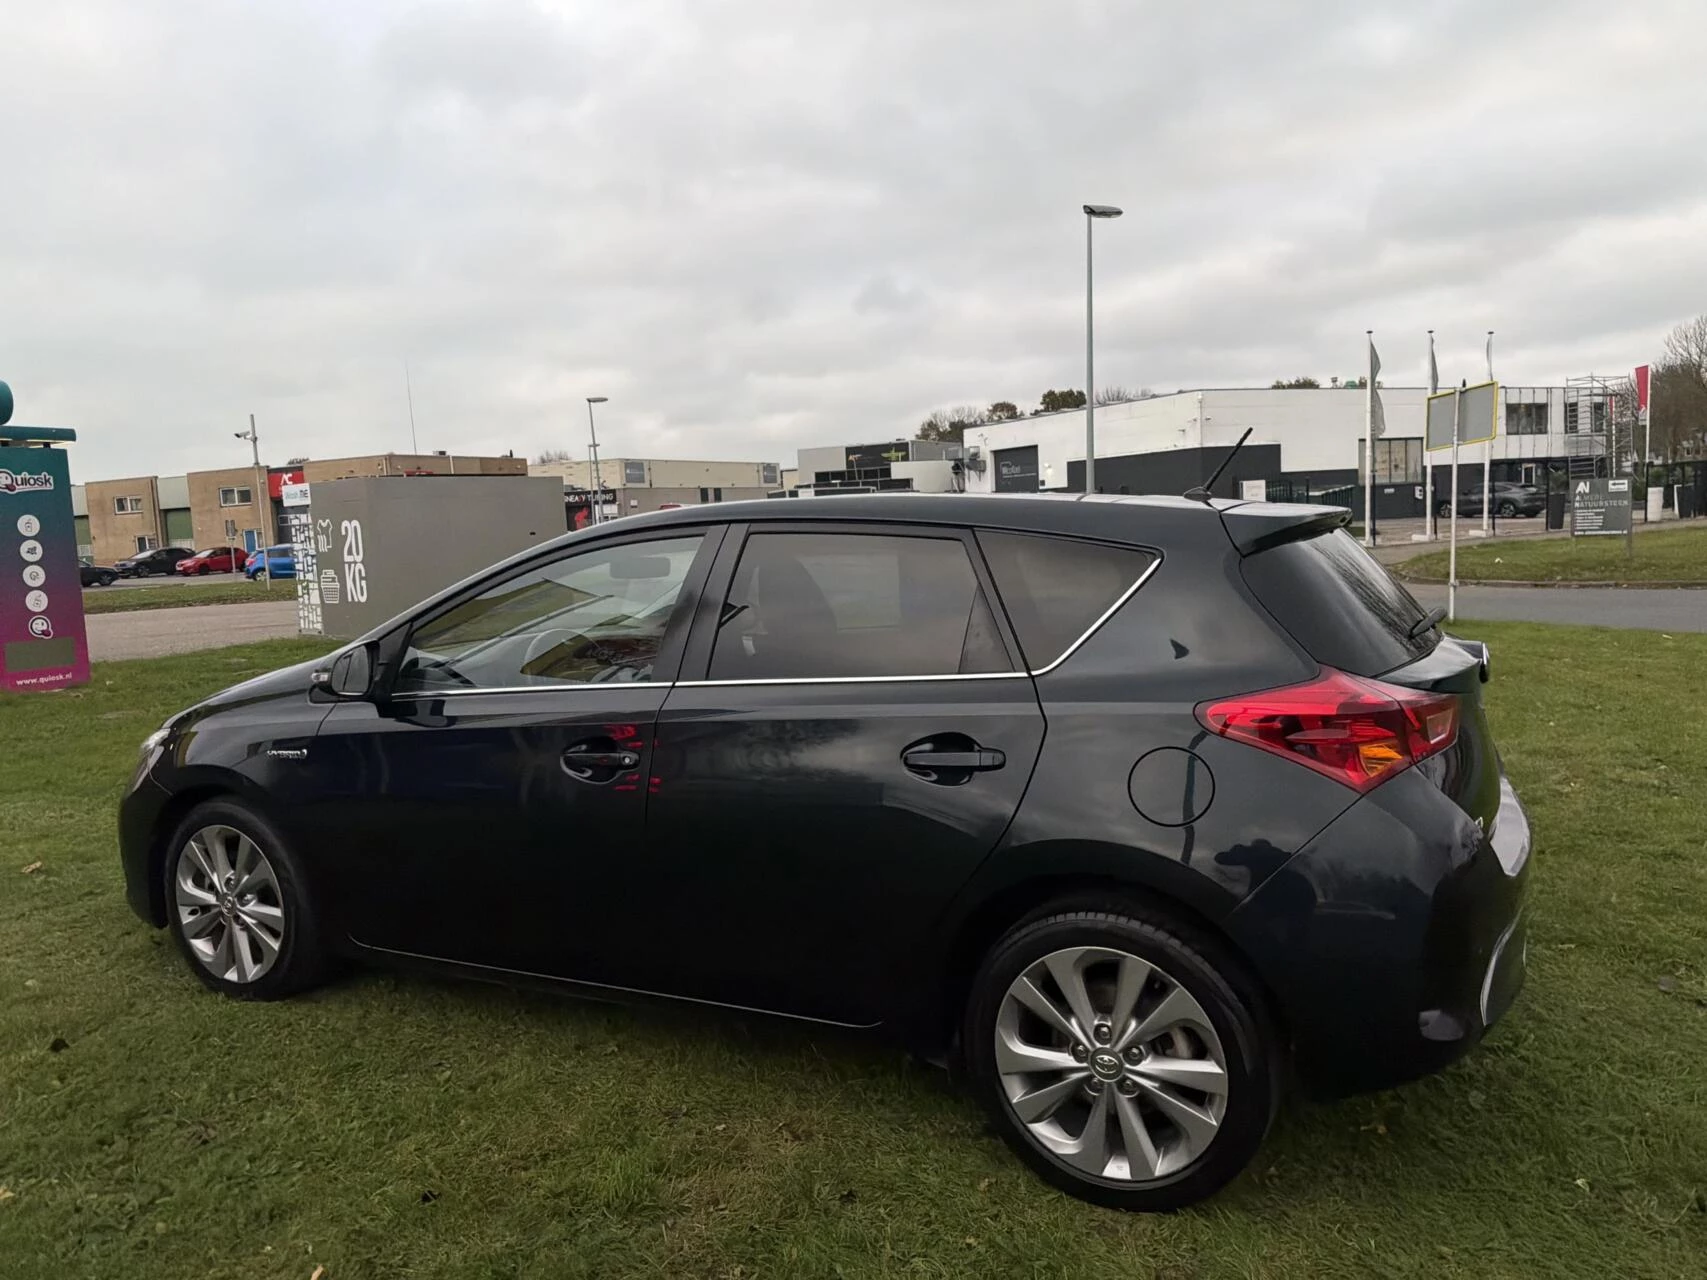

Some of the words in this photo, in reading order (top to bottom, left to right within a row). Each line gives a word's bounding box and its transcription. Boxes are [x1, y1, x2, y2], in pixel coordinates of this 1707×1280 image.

[0, 470, 53, 491] Quiosk
[341, 519, 364, 563] 20
[344, 563, 368, 603] KG
[16, 672, 73, 686] www.quiosk.nl
